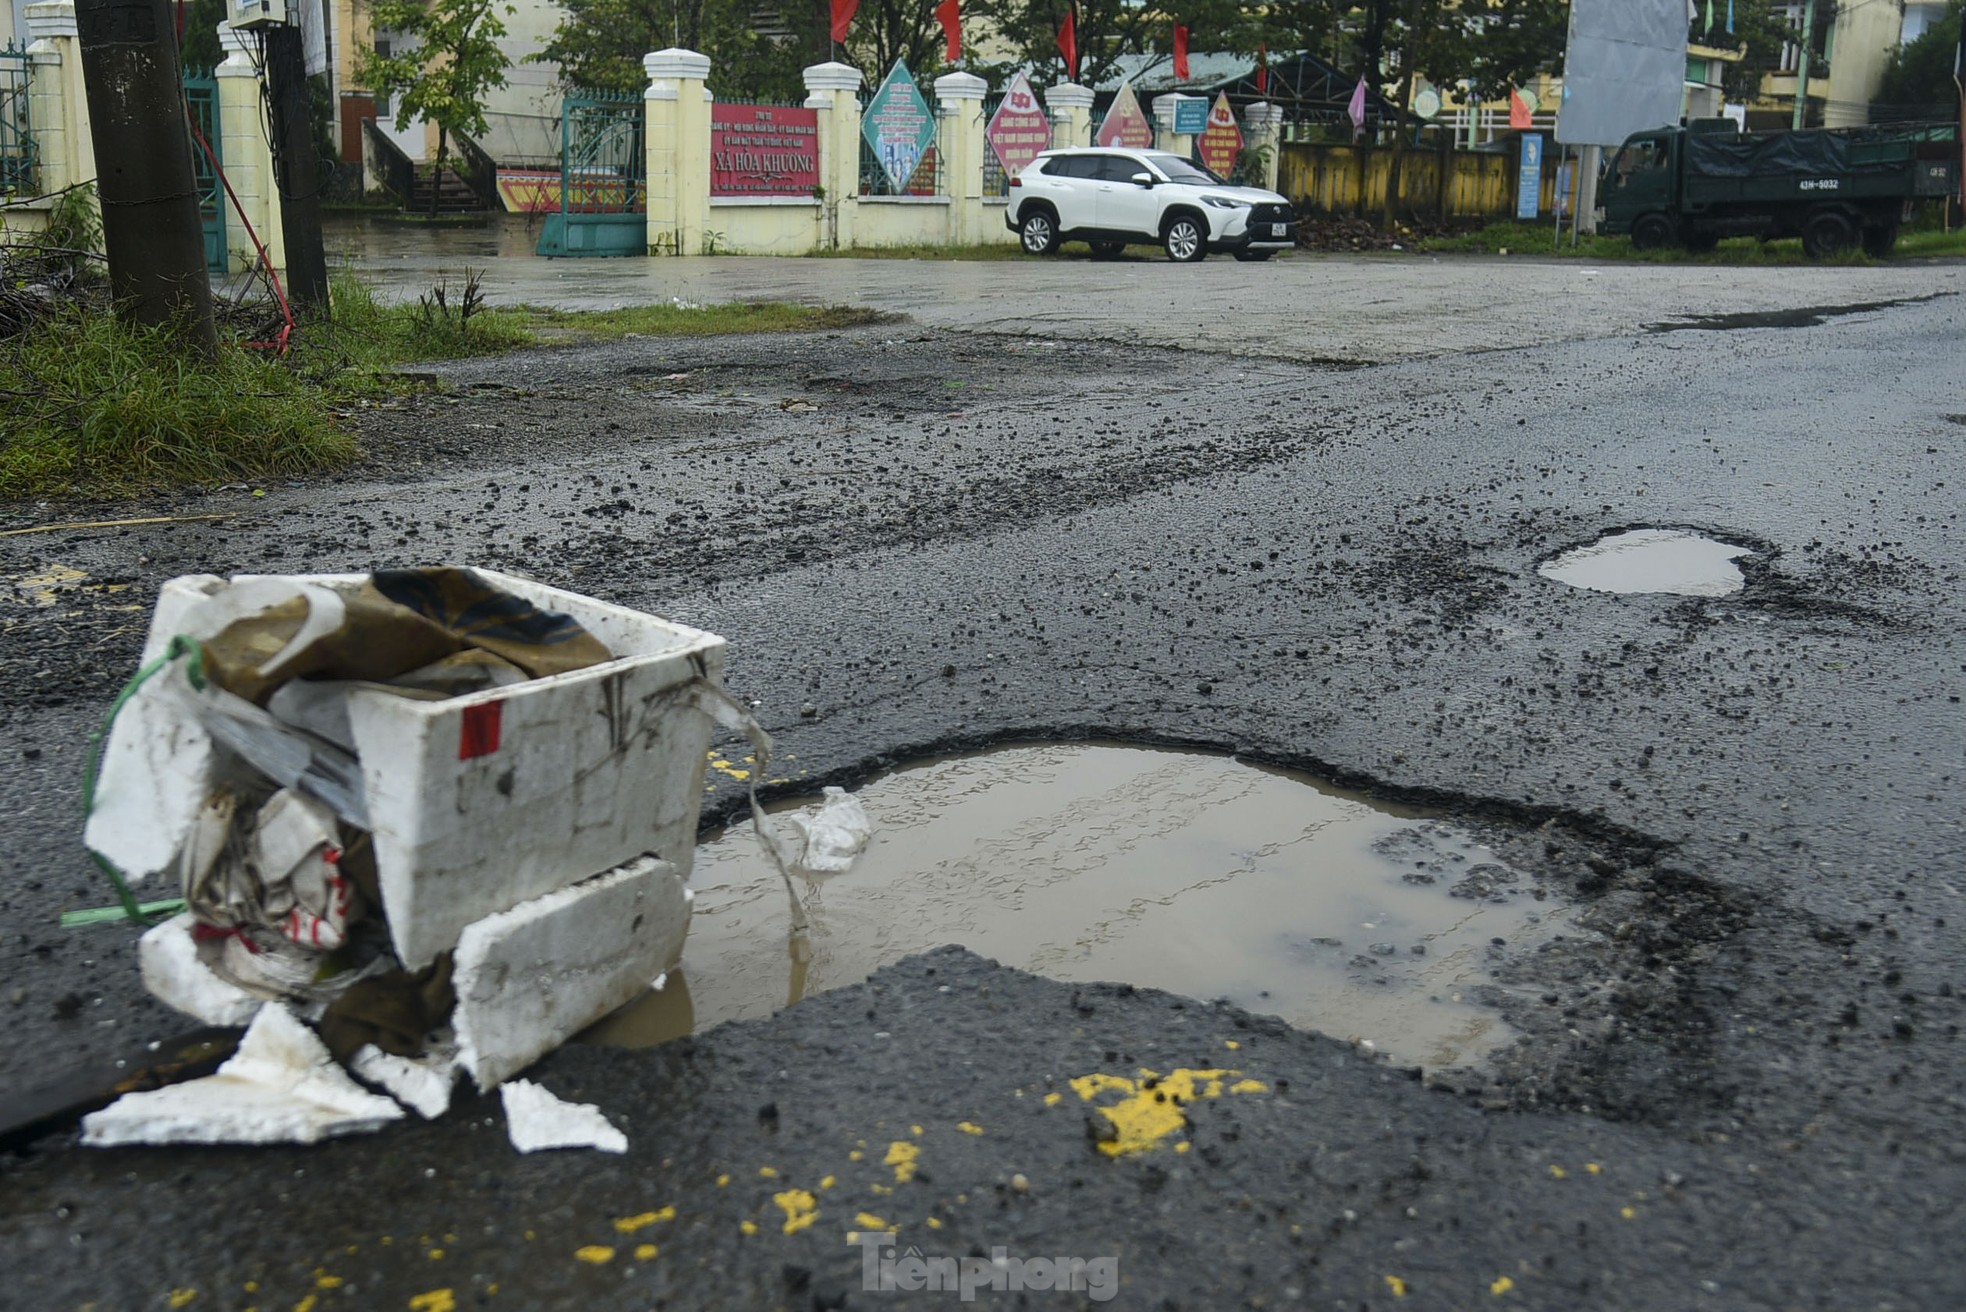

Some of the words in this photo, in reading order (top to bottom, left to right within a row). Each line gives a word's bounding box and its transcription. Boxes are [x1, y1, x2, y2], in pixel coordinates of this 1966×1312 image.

[715, 148, 733, 171] XÃ
[735, 147, 761, 171] HÒA
[762, 152, 814, 173] KHƯƠNG
[1799, 179, 1839, 190] 43H-5032
